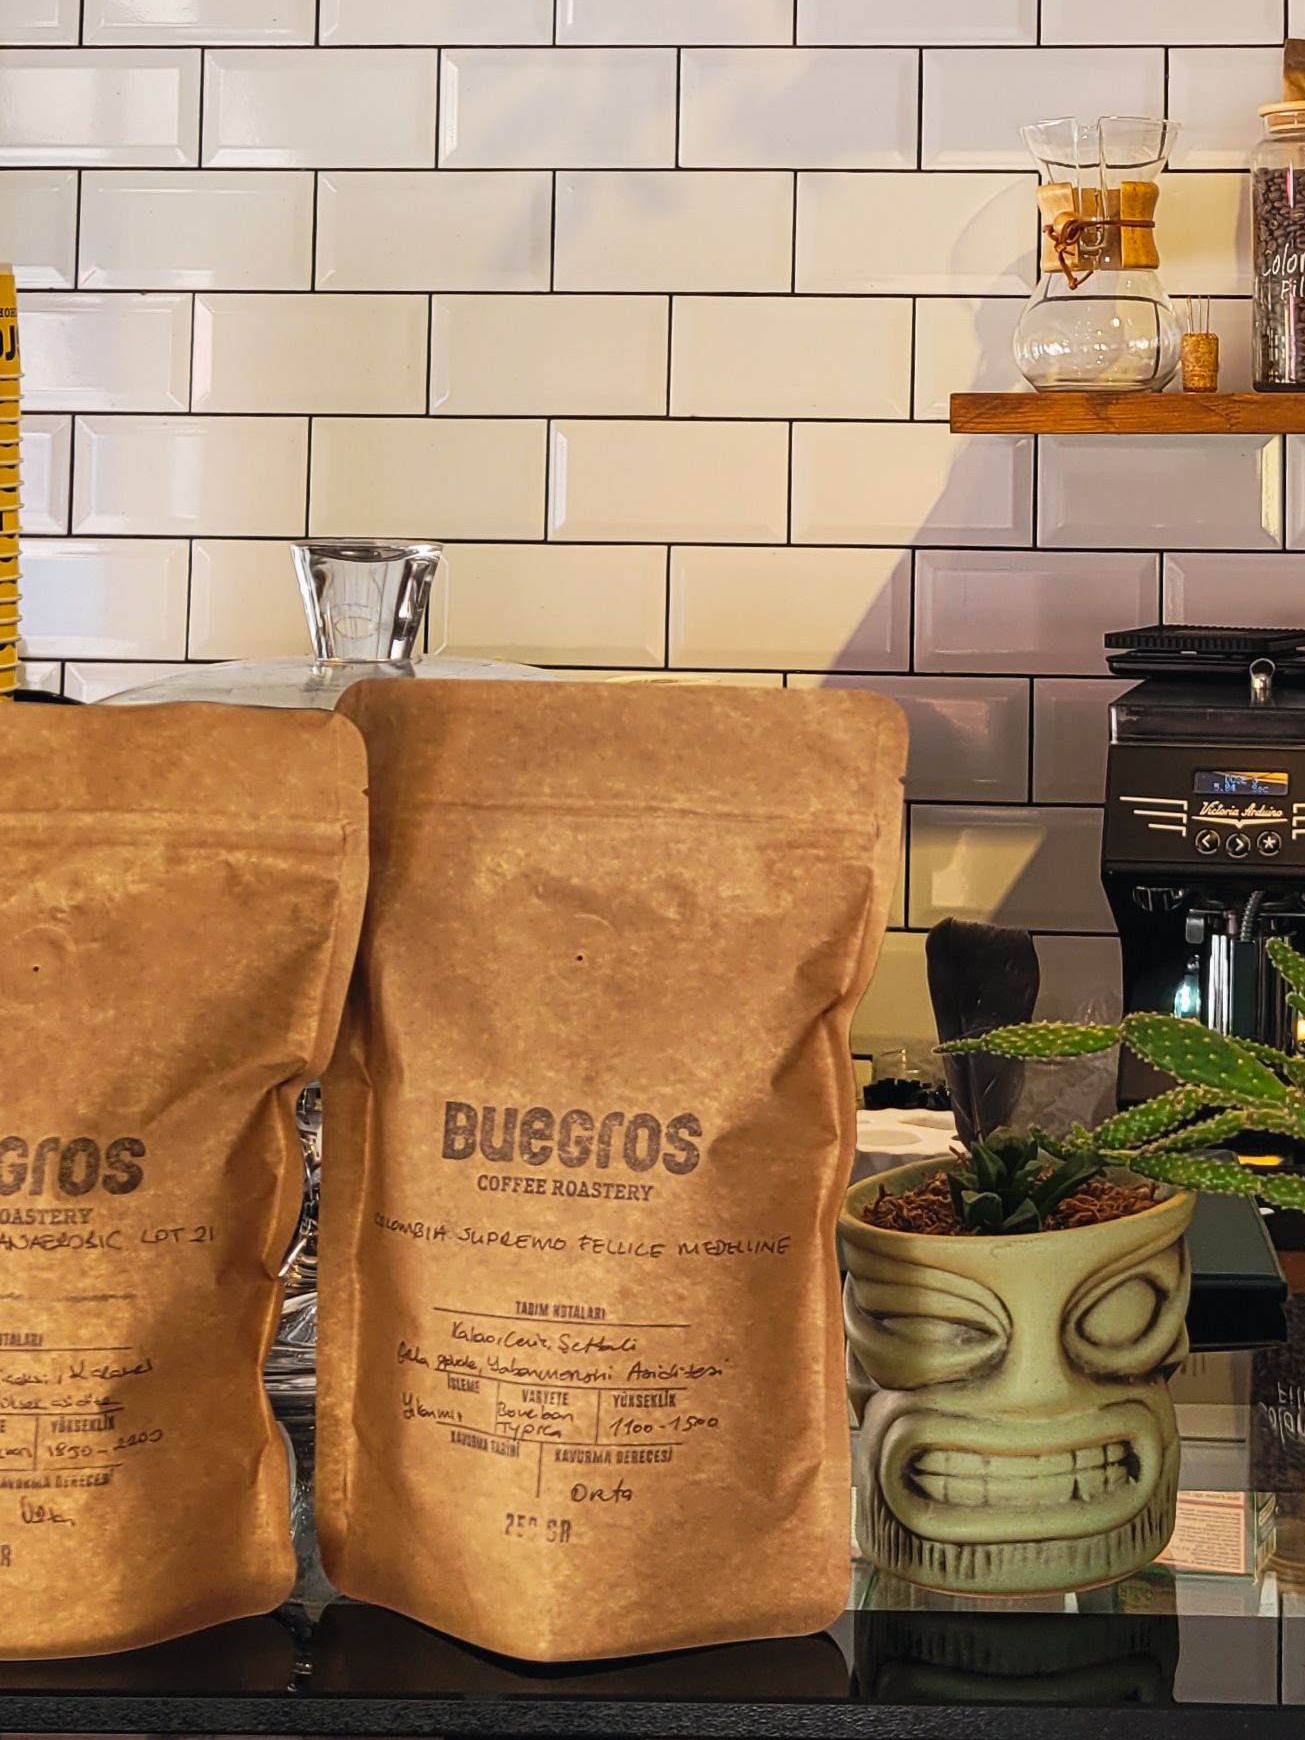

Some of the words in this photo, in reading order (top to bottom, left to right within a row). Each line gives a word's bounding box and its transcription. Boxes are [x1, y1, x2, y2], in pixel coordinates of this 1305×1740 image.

[1200, 801, 1239, 816] Victoria
[1241, 803, 1284, 817] Arduino
[477, 1173, 548, 1196] COFFEE
[551, 1178, 655, 1202] ROASTERY
[457, 1226, 567, 1251] SUPREMO
